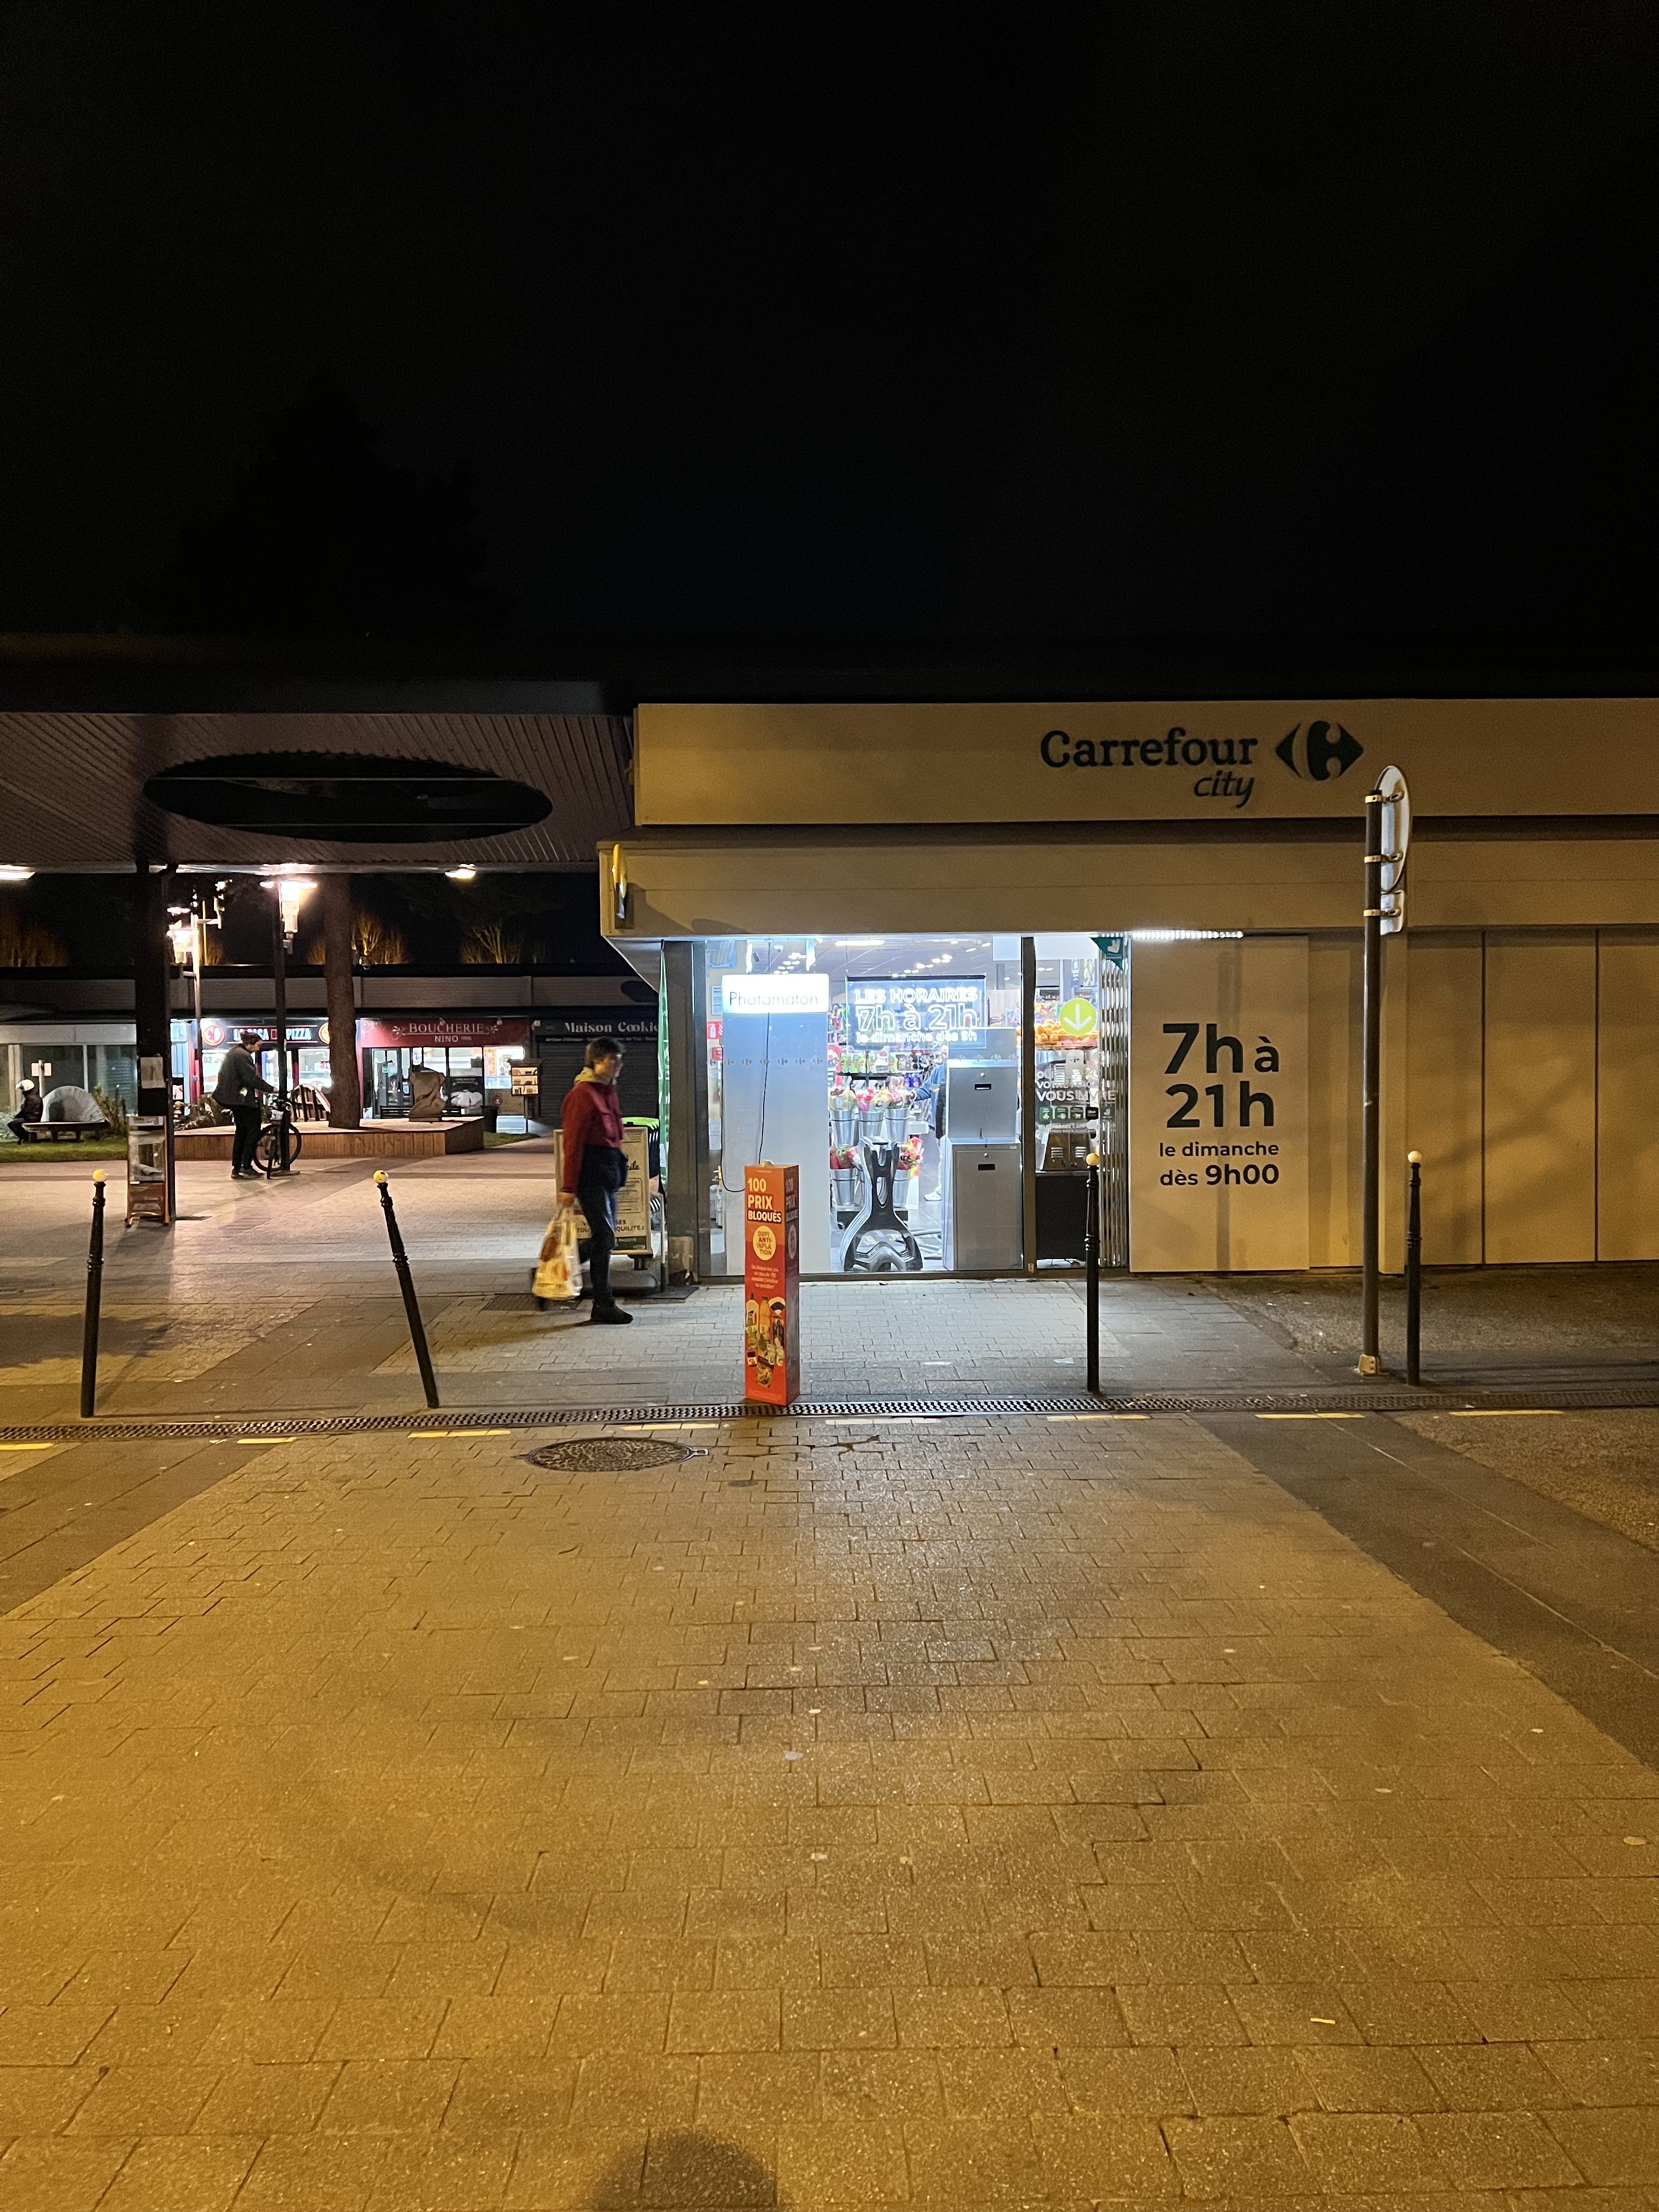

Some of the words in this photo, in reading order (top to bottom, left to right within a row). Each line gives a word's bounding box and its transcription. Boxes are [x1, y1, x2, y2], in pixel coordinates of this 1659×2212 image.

[1041, 727, 1258, 768] Carrefour
[1194, 770, 1255, 808] city
[730, 991, 818, 1006] Photomaton
[855, 989, 887, 1004] LES
[890, 986, 978, 1003] HORAIRES
[856, 1005, 896, 1031] 7h
[903, 1003, 921, 1031] à
[928, 1003, 978, 1030] 21h
[286, 1028, 312, 1040] PIZZA
[409, 1023, 484, 1033] BOUCHERIE
[565, 1022, 612, 1033] Maison
[856, 1031, 868, 1043] le
[871, 1031, 934, 1043] dimanche
[936, 1030, 959, 1042] dès
[961, 1030, 977, 1042] 9h
[1163, 1023, 1244, 1074] 7h
[1254, 1036, 1279, 1073] à
[1036, 1090, 1075, 1101] VOUS
[1165, 1081, 1274, 1128] 21h
[1160, 1143, 1176, 1157] le
[1182, 1141, 1279, 1156] dimanche
[1160, 1169, 1198, 1186] dès
[1205, 1164, 1279, 1185] 9h00
[748, 1177, 766, 1192] 100
[748, 1194, 773, 1210] PRIX
[748, 1209, 782, 1223] BLOQUÉS
